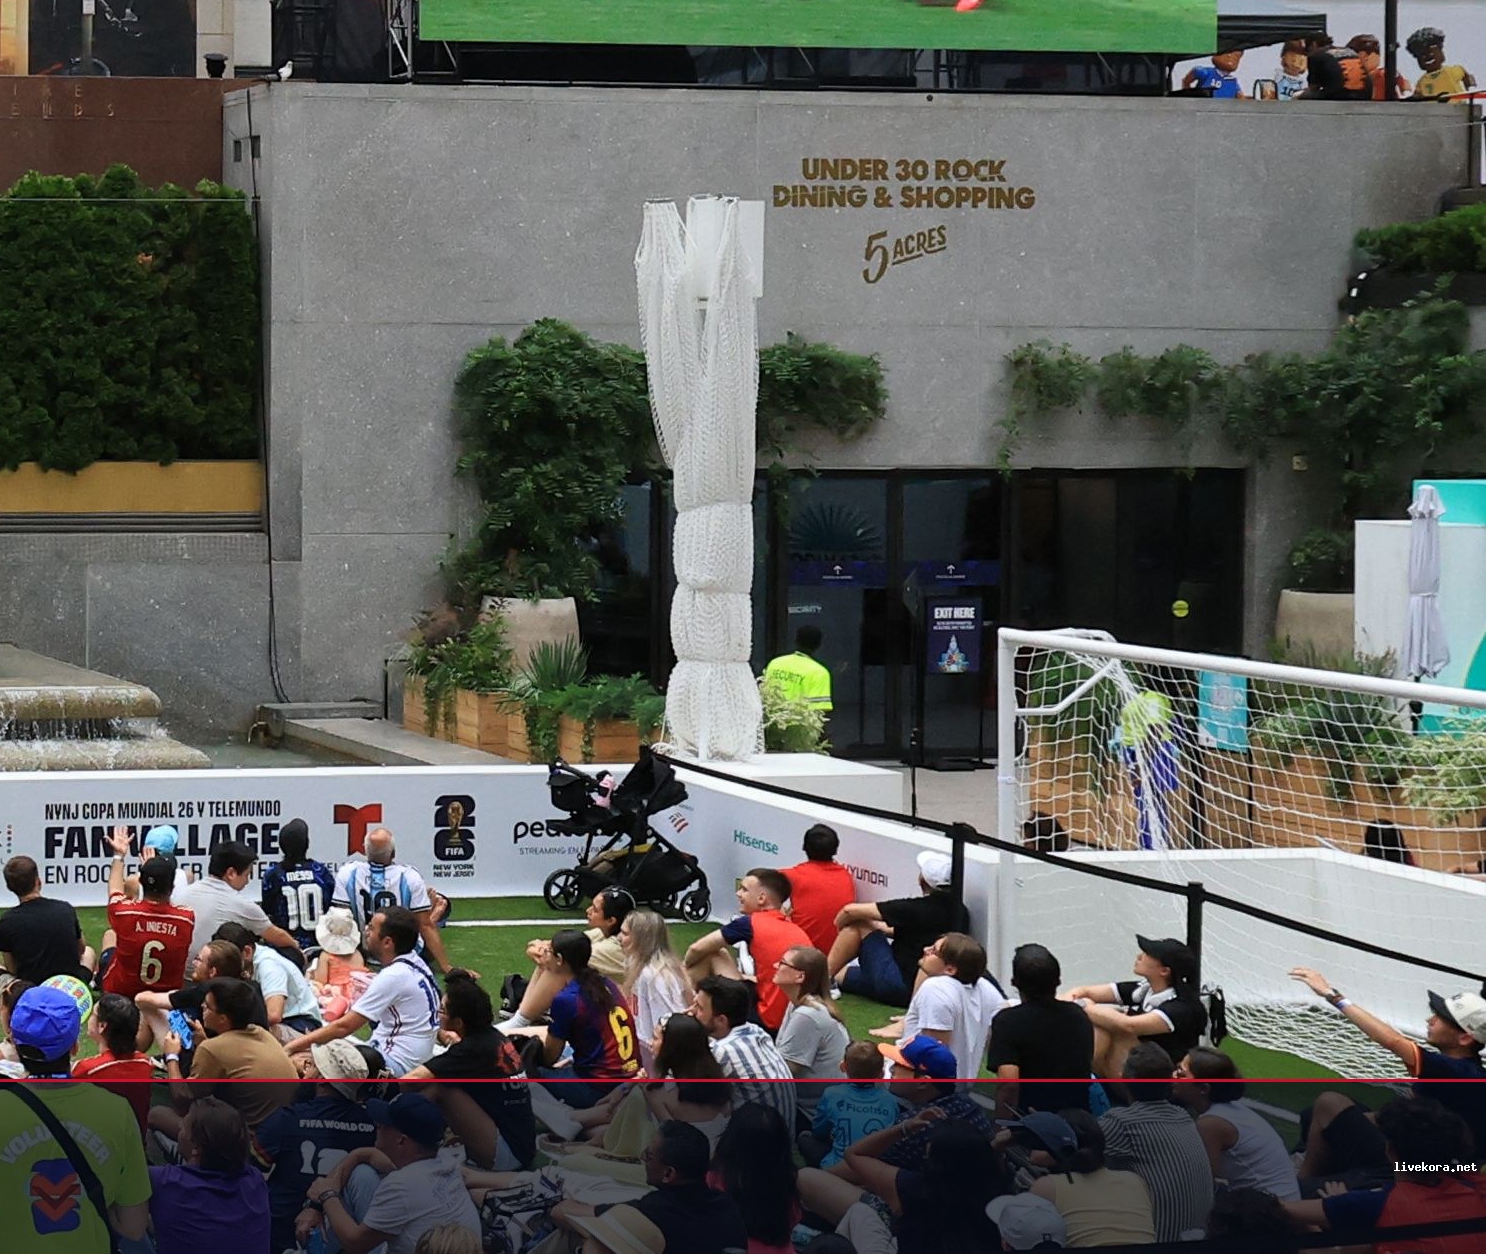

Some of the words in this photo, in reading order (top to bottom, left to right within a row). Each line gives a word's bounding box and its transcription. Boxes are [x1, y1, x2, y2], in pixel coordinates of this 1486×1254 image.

[802, 158, 889, 181] UNDER
[895, 159, 928, 181] 30
[935, 159, 1007, 182] ROCK
[773, 185, 868, 208] DINING
[873, 185, 894, 208] &
[900, 186, 1036, 210] SHOPPING
[862, 230, 889, 284] 5
[892, 224, 947, 262] ACRES
[934, 607, 953, 620] EXIT
[954, 607, 976, 619] HERE
[772, 668, 806, 686] SECURITY
[45, 803, 78, 820] NYNJ
[82, 803, 114, 819] COPA
[118, 802, 175, 819] MUNDIAL
[178, 801, 193, 817] 26
[197, 801, 204, 817] Y
[209, 800, 281, 817] TELEMUNDO
[444, 847, 465, 856] FIFA
[519, 846, 566, 856] STREAMING
[733, 829, 779, 855] Hisense
[45, 865, 68, 884] EN
[286, 870, 314, 882] MESSI
[281, 883, 323, 931] 10
[135, 921, 145, 934] A.
[146, 921, 177, 937] INIESTA
[140, 940, 165, 985] 6
[609, 1006, 634, 1062] 6
[299, 1120, 320, 1130] FIFA
[321, 1121, 357, 1133] WORLD
